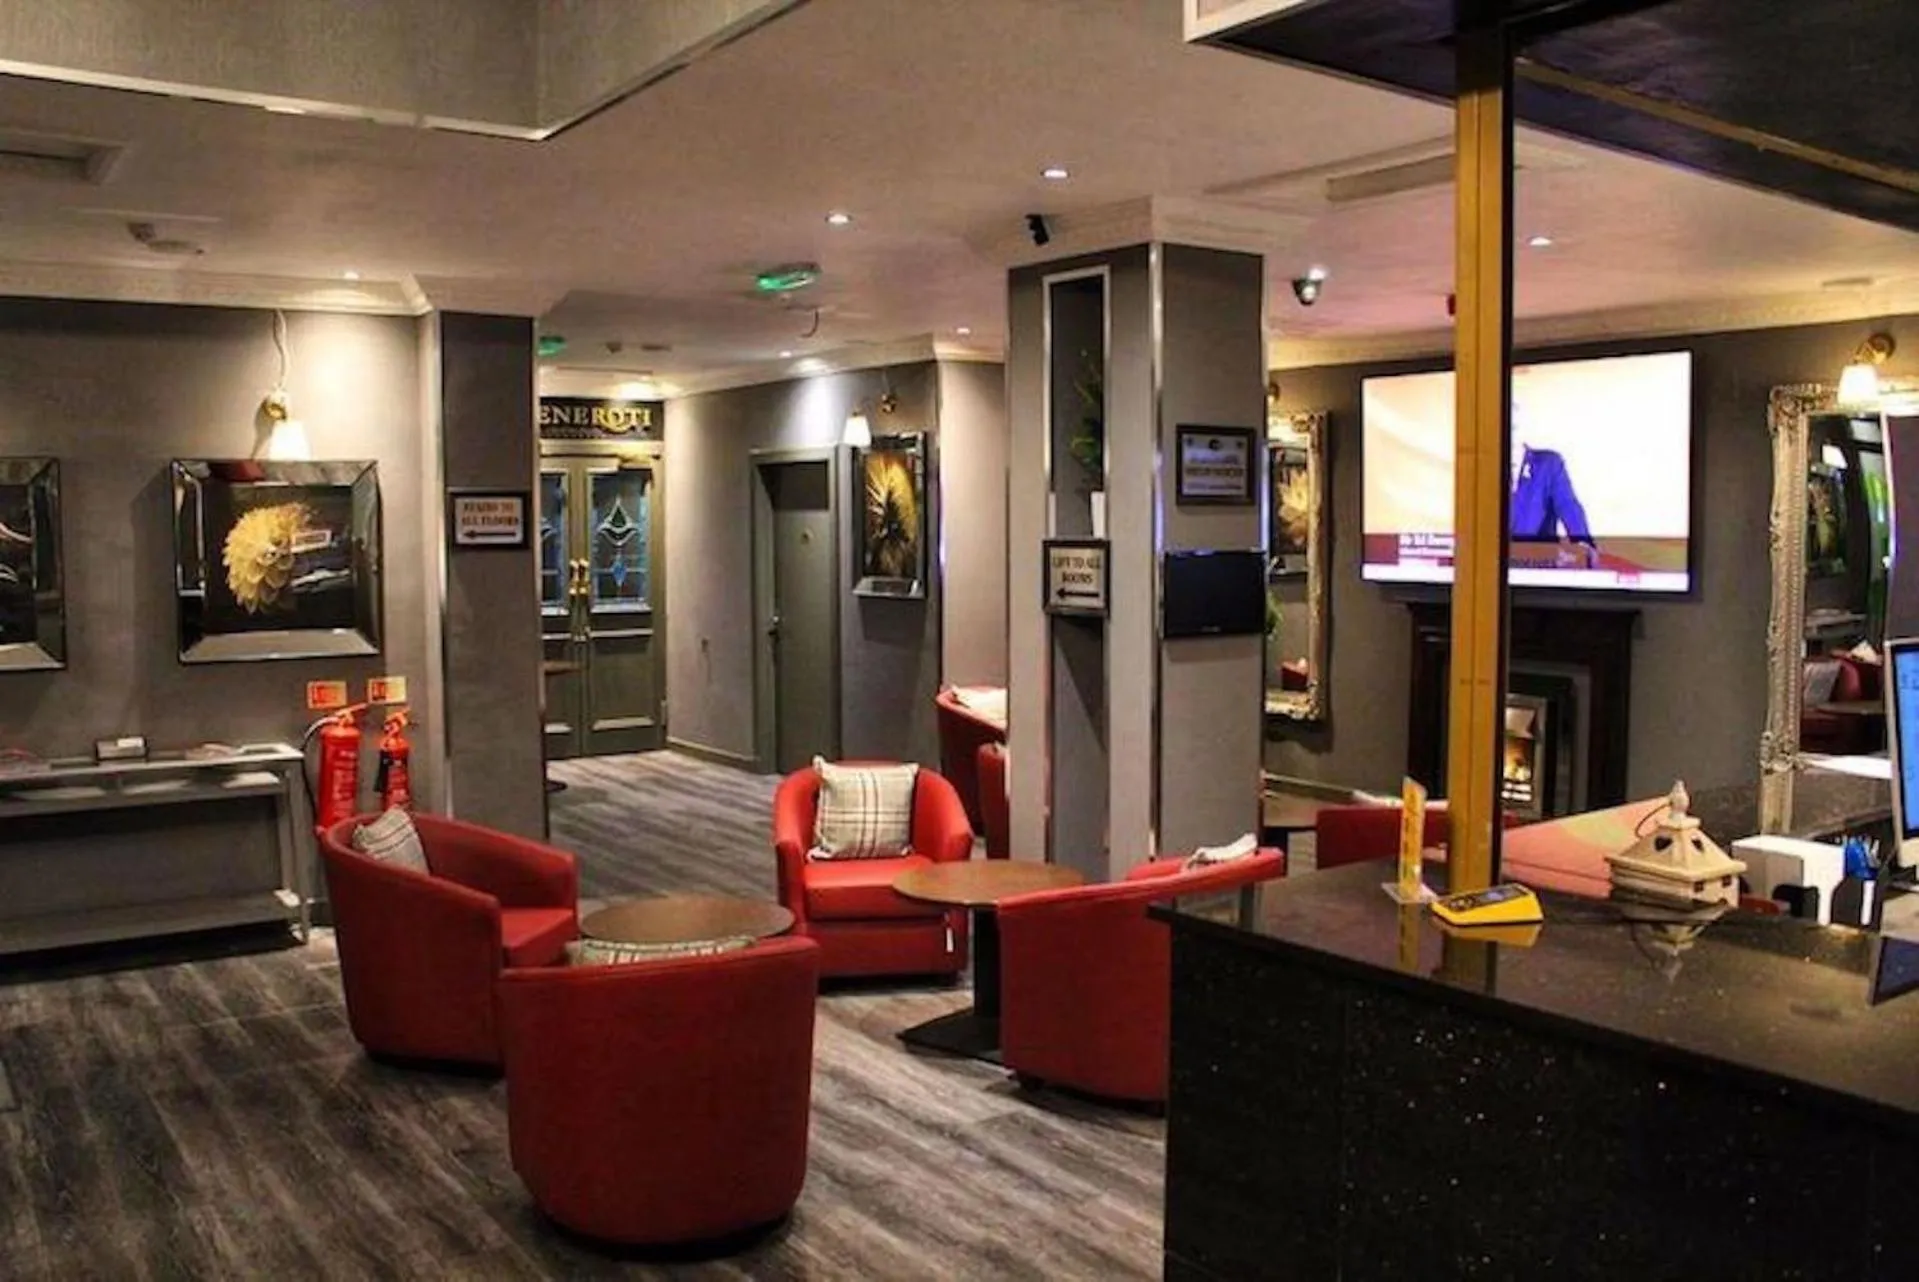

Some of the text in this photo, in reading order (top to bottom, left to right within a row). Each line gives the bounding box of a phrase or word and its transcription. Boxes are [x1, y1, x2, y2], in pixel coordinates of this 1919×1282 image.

[1072, 556, 1085, 568] TO
[1086, 555, 1101, 569] ALL
[1061, 571, 1093, 583] ROOMS
